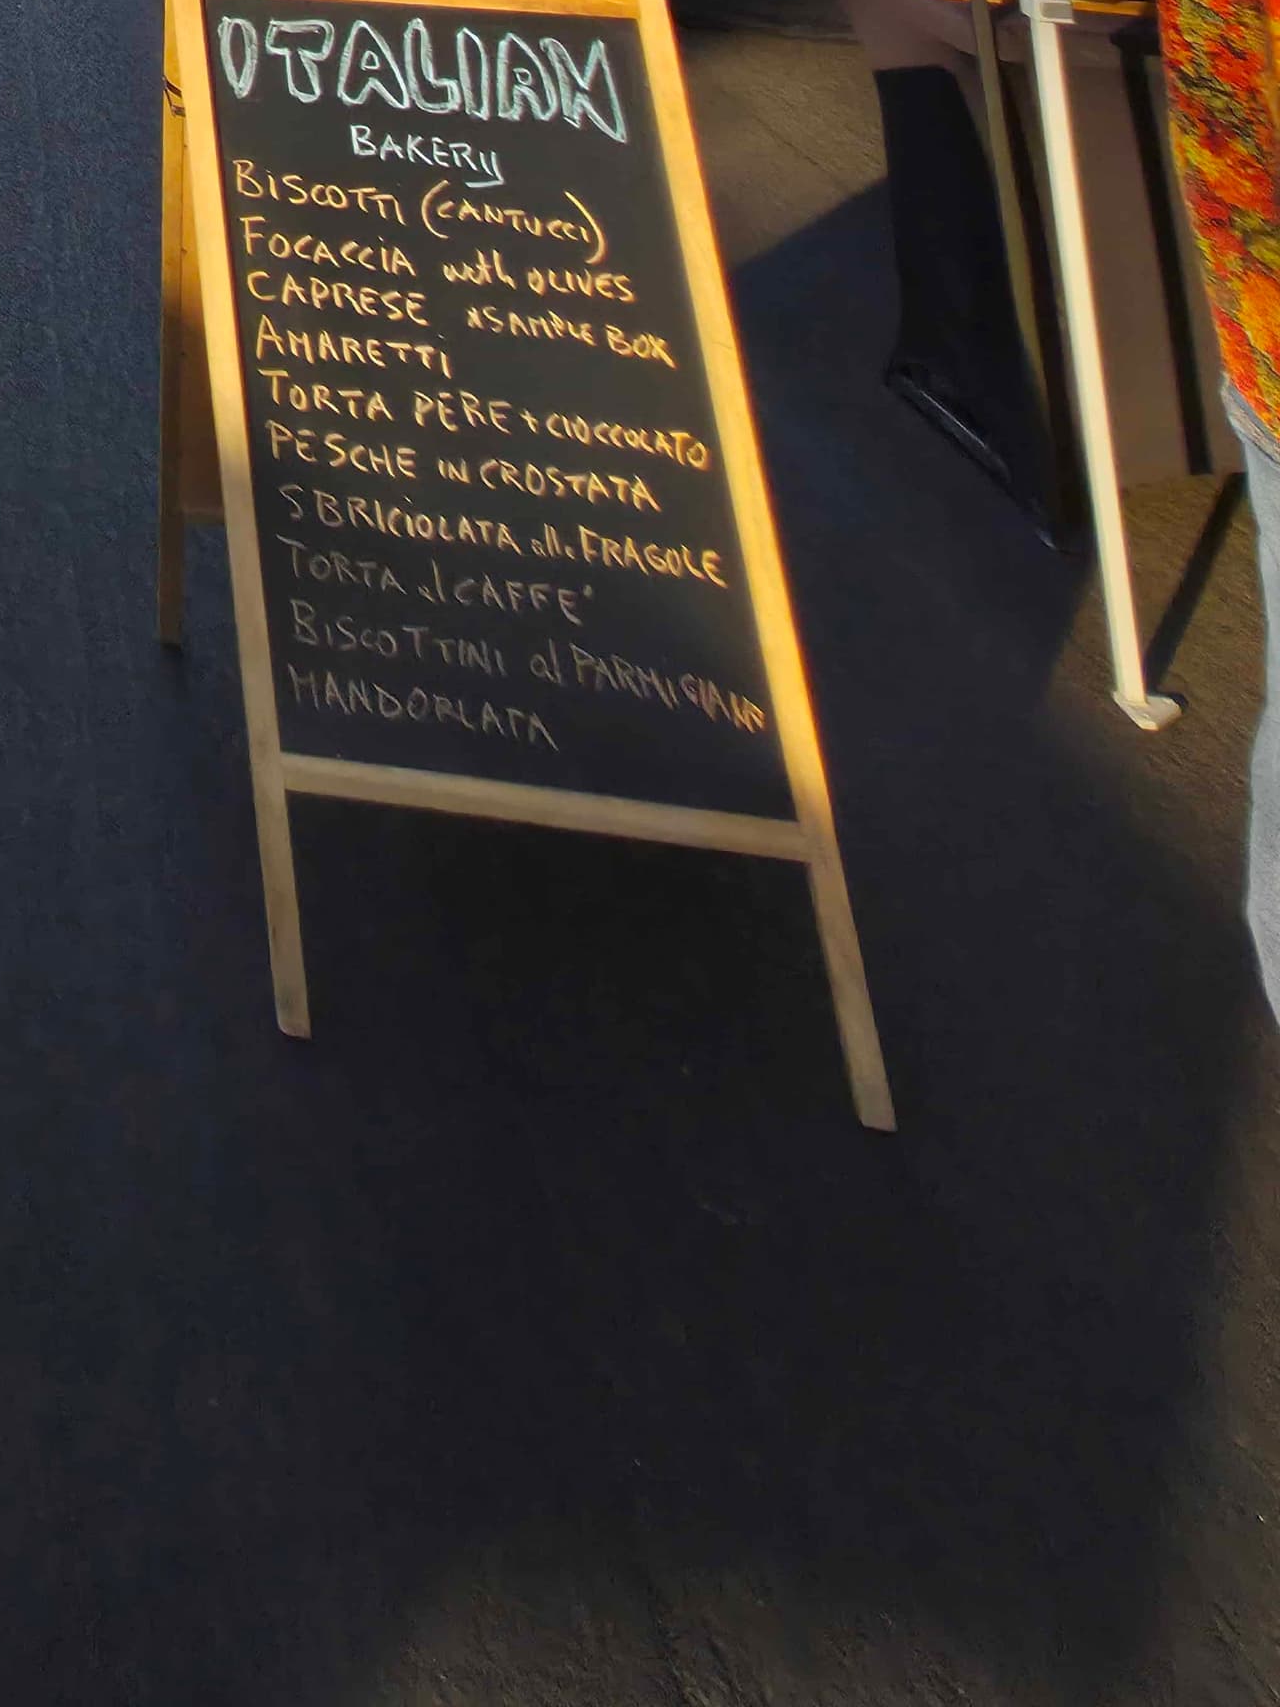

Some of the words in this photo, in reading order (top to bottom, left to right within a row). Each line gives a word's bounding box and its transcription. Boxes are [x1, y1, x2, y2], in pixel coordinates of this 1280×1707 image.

[218, 16, 627, 143] ITALIAN
[247, 271, 431, 327] CAPRESE
[604, 323, 678, 370] BOX
[527, 267, 638, 304] OLIVES
[257, 368, 395, 422] TORTA
[412, 390, 512, 436] PERE
[264, 419, 417, 479] PESCHE
[437, 457, 472, 484] IN
[480, 458, 662, 513] CROSTATA
[275, 533, 408, 596] TORTA
[578, 524, 729, 589] FRAGOLE
[287, 662, 560, 752] MANDORLATA
